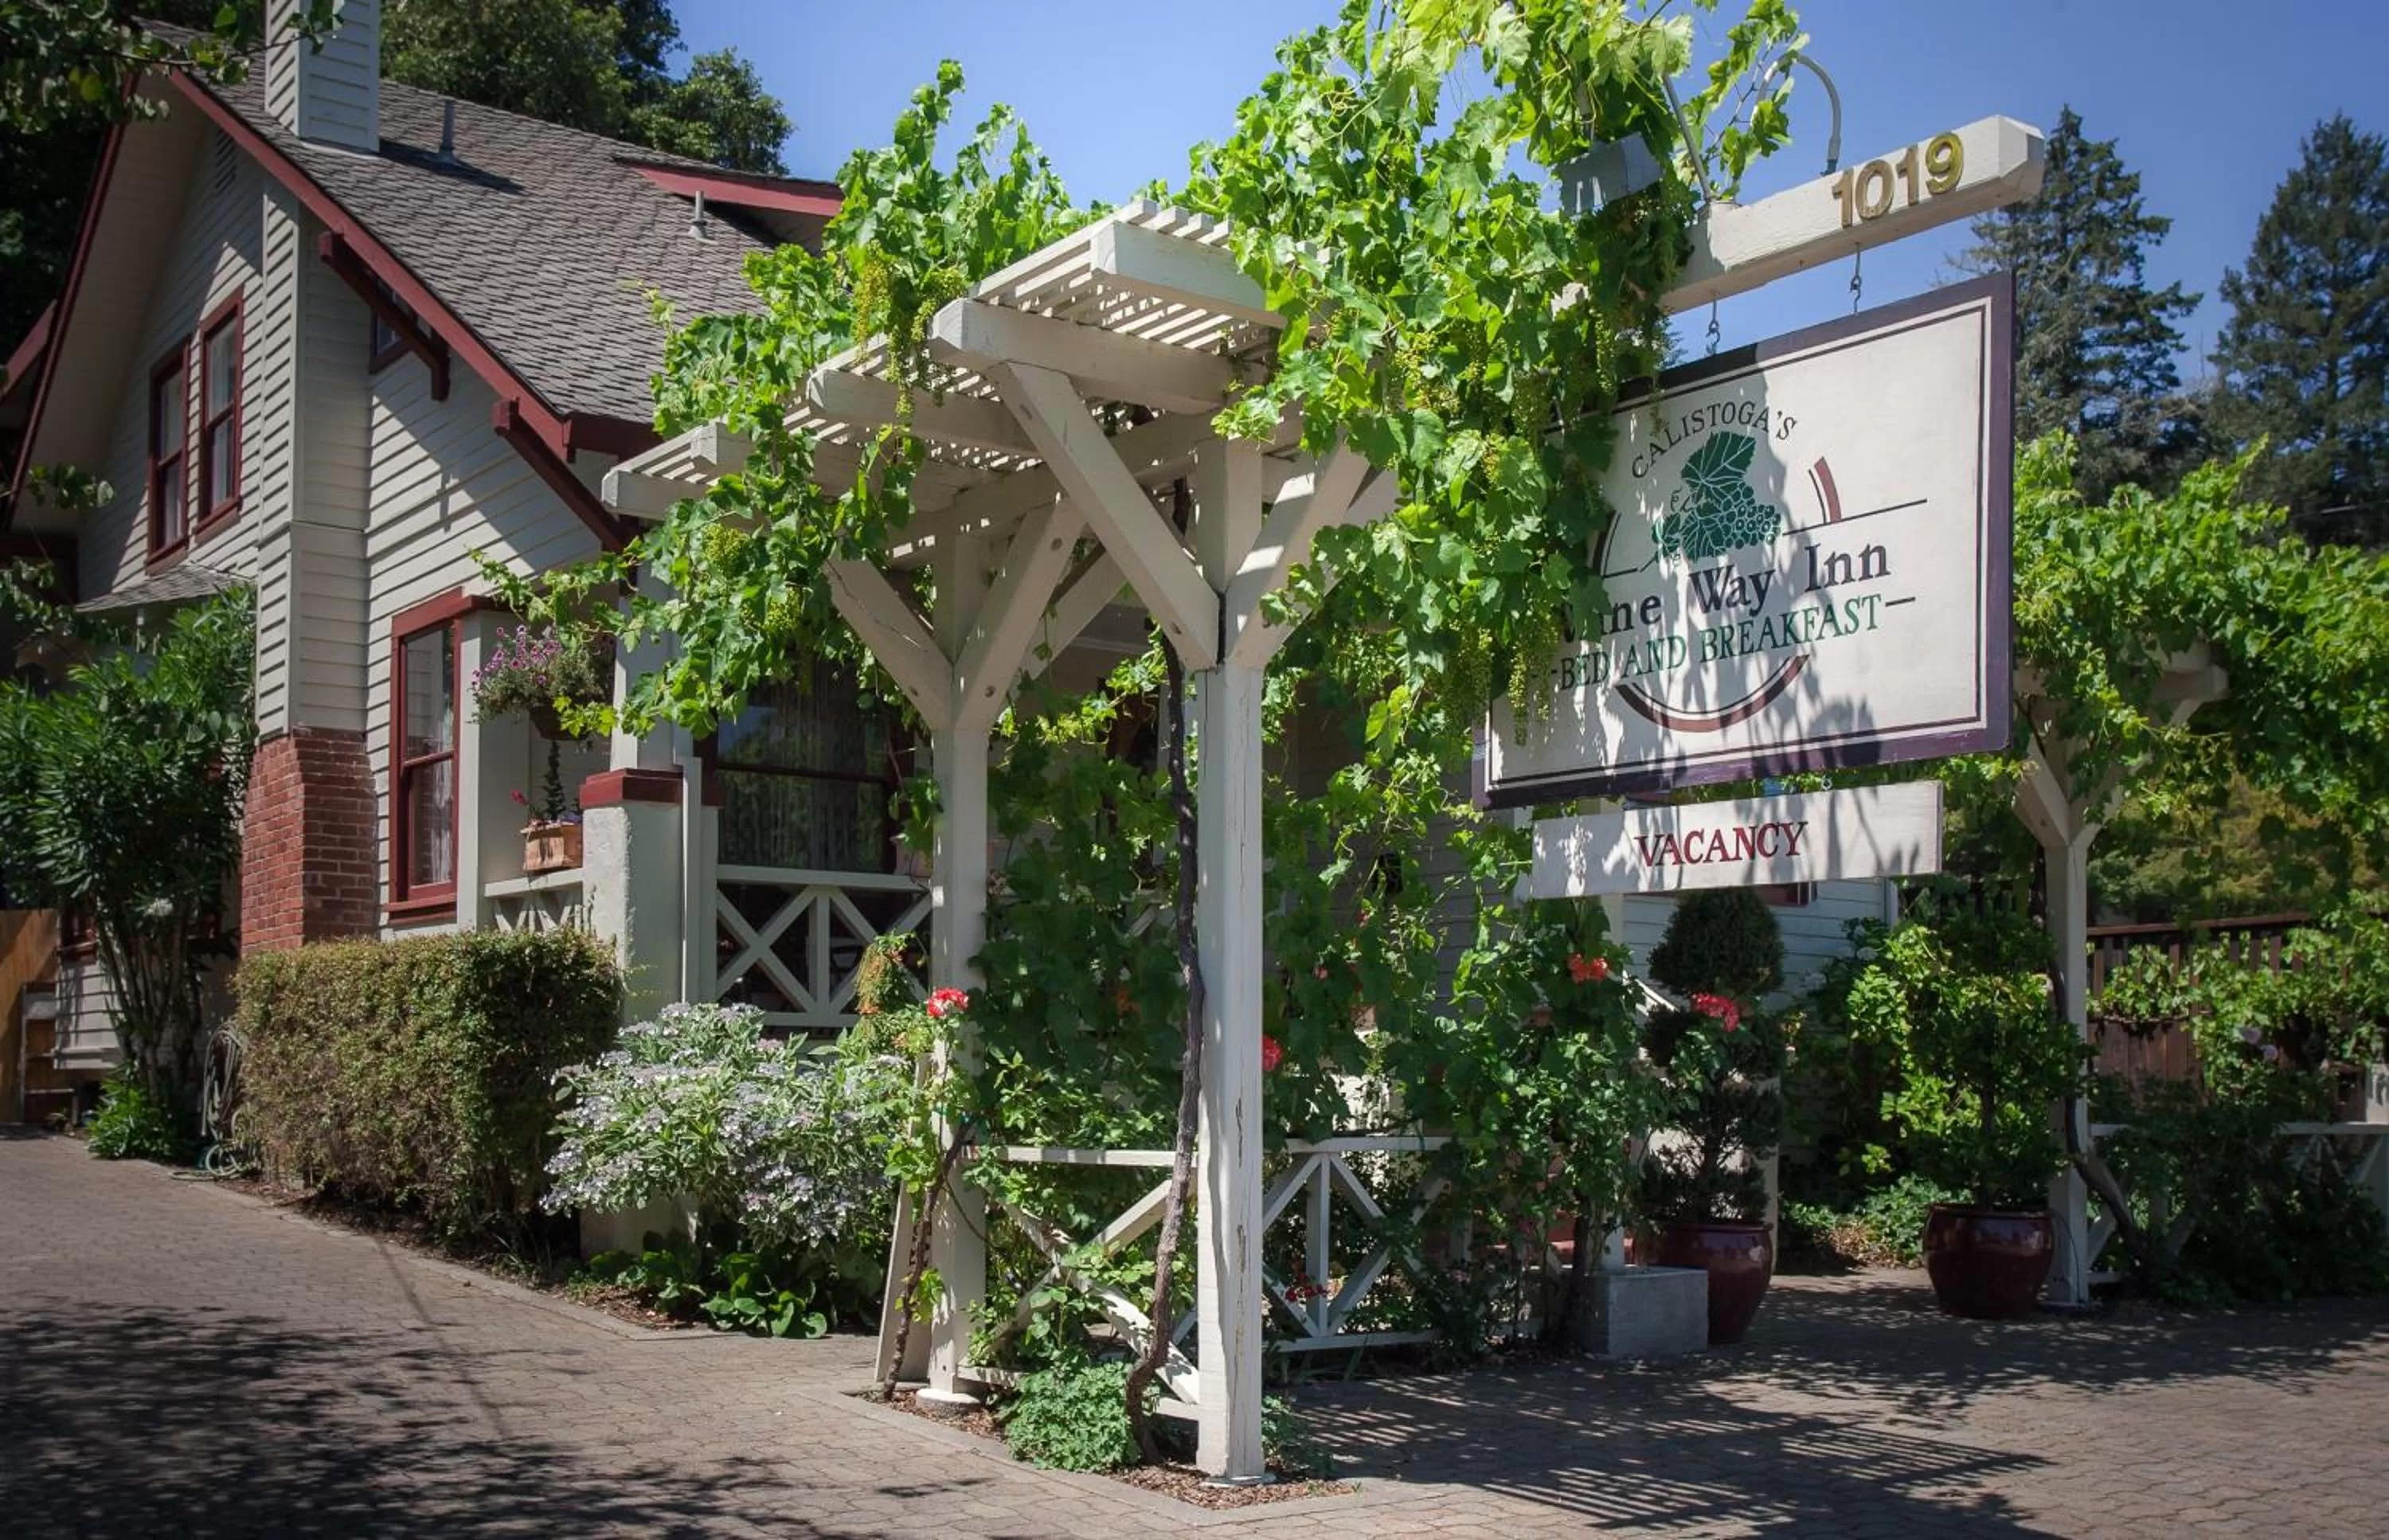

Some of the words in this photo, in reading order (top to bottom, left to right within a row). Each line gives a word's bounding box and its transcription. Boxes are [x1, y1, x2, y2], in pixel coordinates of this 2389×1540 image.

[1832, 131, 1964, 227] 1019
[1632, 401, 1797, 478] CALISTOGA'S
[1689, 563, 1775, 616] Way
[1804, 542, 1890, 592] Inn
[1560, 651, 1609, 690] BED
[1621, 635, 1687, 678] AND
[1699, 593, 1881, 663] BREAKFAST
[1634, 821, 1808, 866] VACANCY
